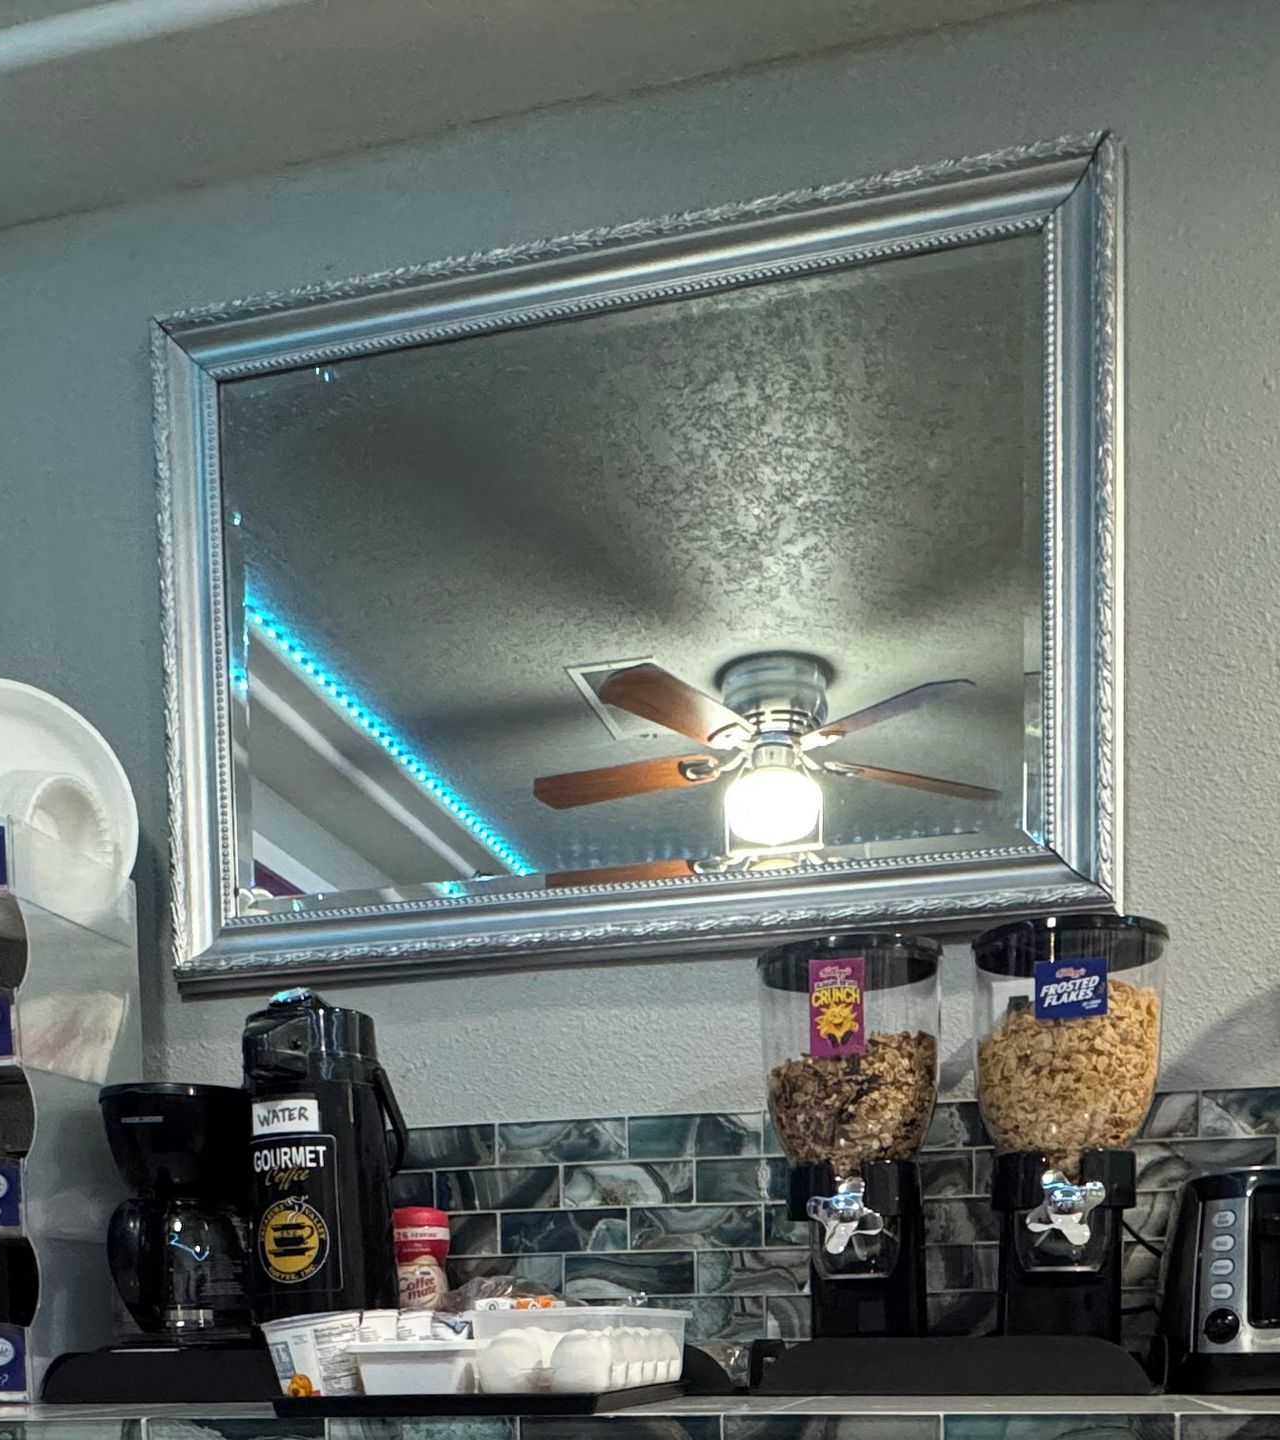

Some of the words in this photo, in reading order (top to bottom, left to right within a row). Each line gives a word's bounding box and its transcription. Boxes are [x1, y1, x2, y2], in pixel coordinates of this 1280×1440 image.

[1040, 976, 1100, 997] FROSTED
[811, 988, 861, 1008] CRUNCH
[1043, 988, 1094, 1008] FLAKES
[257, 1106, 310, 1128] WATER
[253, 1146, 327, 1173] GOURMET
[265, 1167, 311, 1191] Coffee
[400, 1278, 435, 1293] Coffee
[407, 1285, 437, 1300] mate
